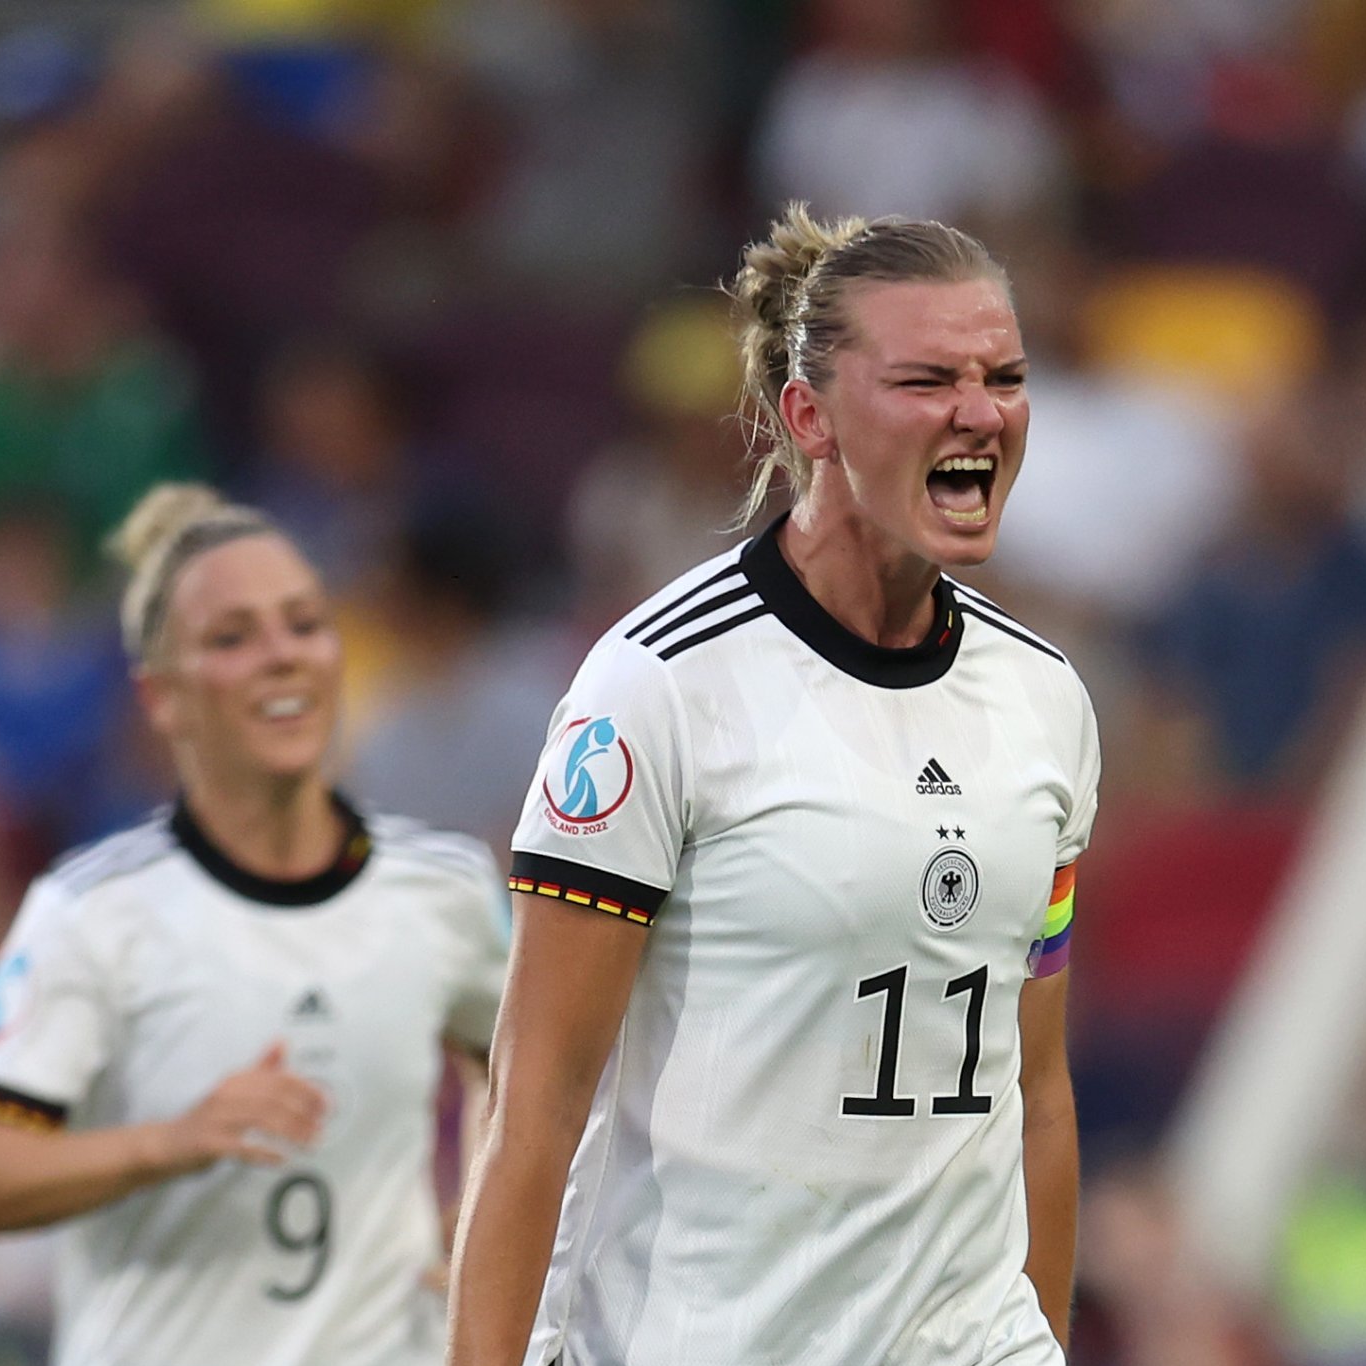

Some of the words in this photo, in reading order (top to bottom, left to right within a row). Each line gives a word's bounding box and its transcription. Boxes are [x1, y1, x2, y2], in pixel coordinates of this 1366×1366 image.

[544, 807, 579, 835] ENGLAND
[583, 822, 608, 835] 2022
[915, 783, 962, 795] adidas
[841, 965, 993, 1116] 11
[263, 1172, 332, 1302] 9
